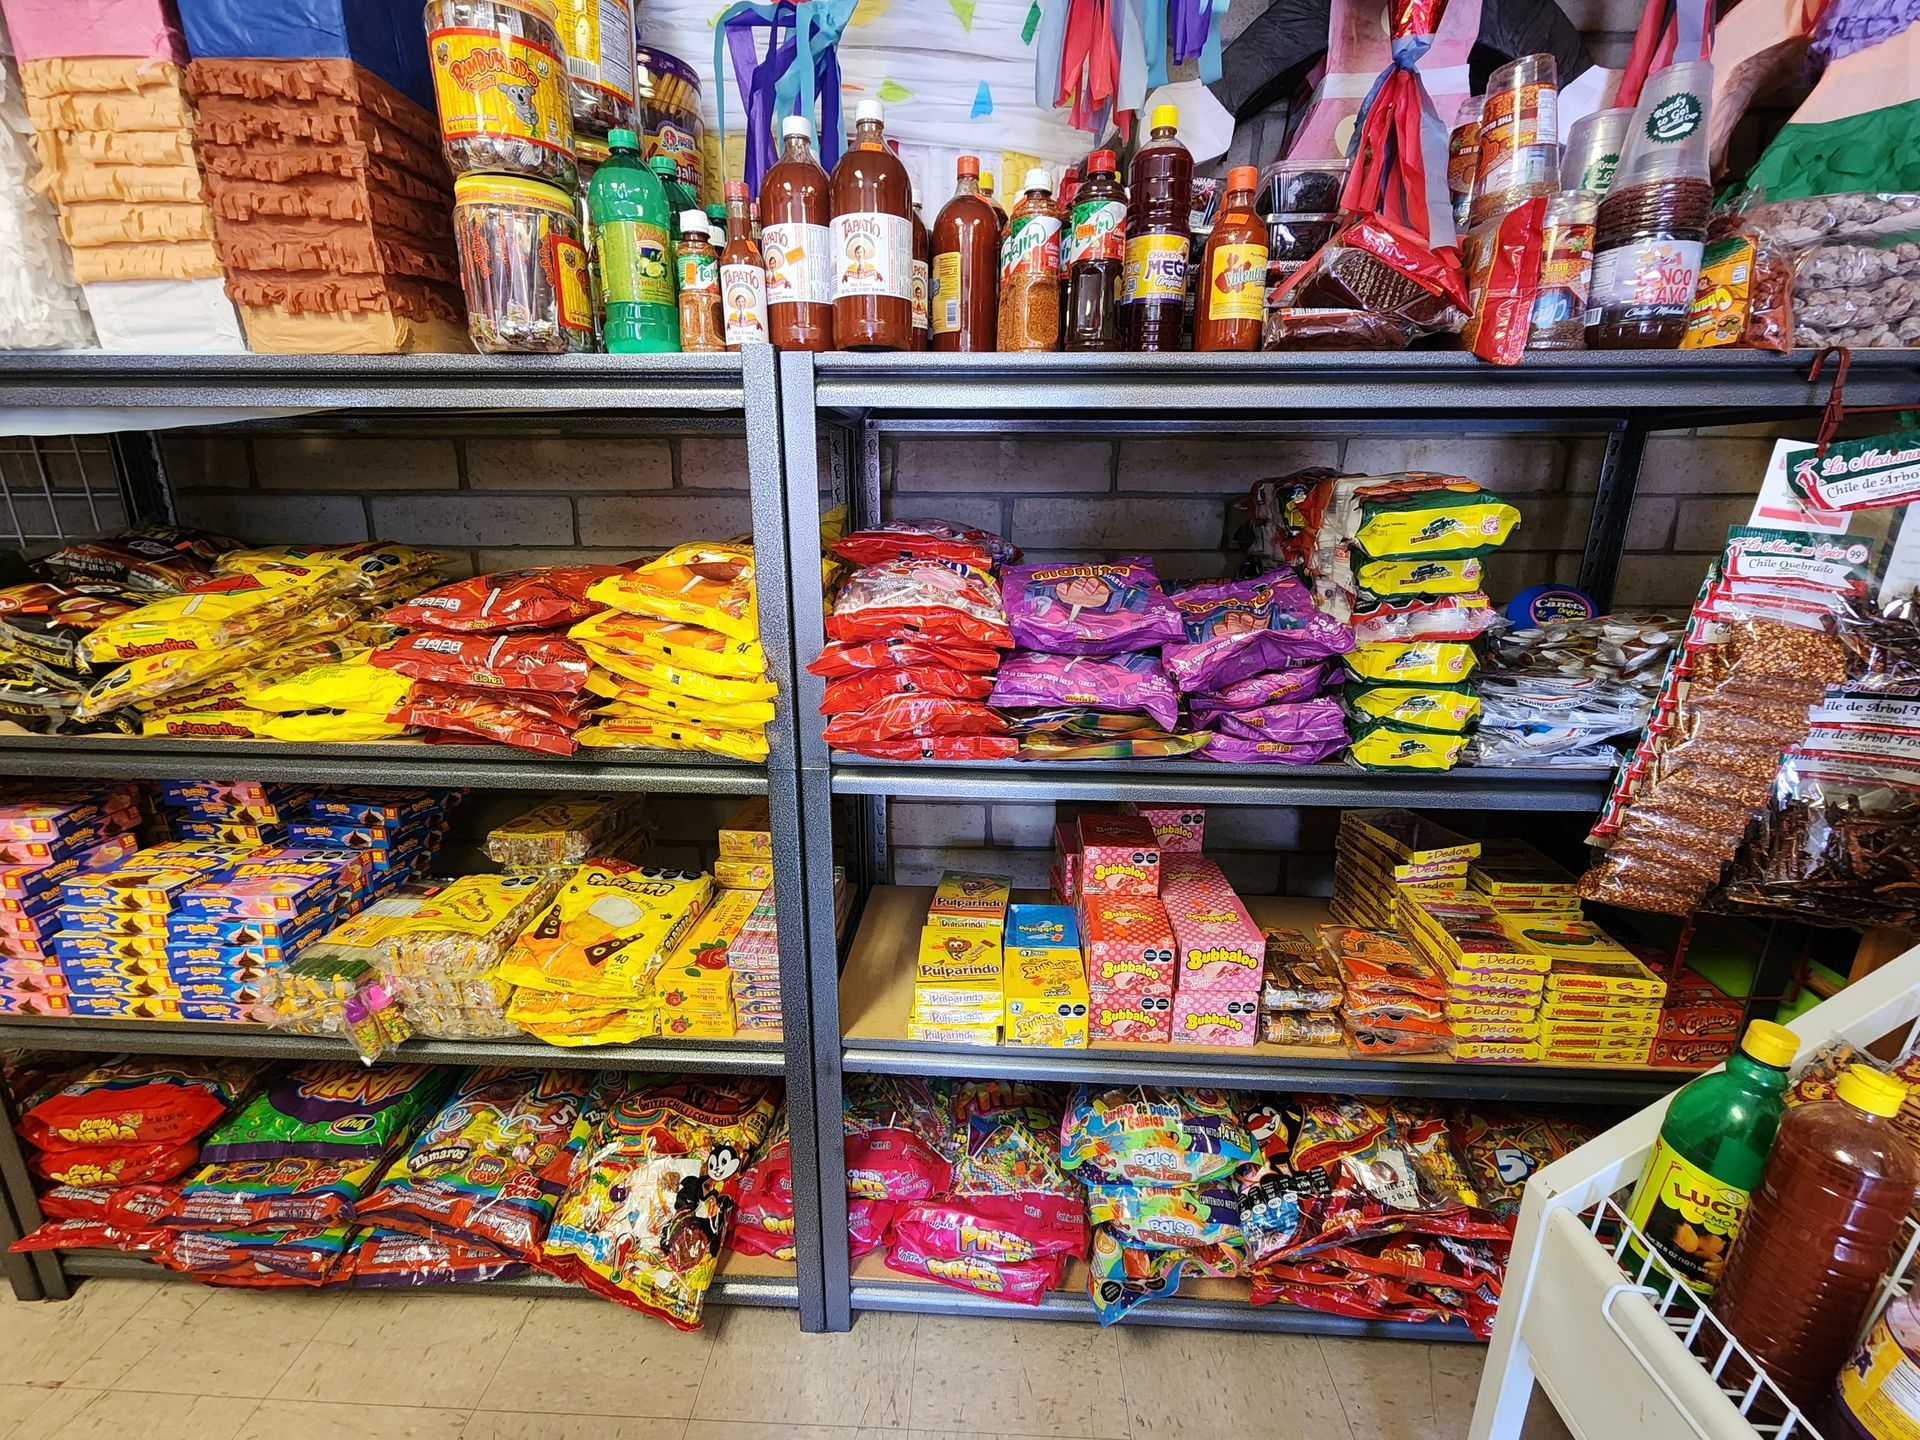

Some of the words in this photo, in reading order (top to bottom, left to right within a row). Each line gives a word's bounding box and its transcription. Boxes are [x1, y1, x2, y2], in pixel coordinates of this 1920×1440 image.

[450, 49, 539, 90] BAMBURINDO
[1653, 97, 1687, 118] Ready
[1657, 117, 1669, 127] to
[1671, 104, 1690, 120] Go!
[842, 217, 881, 241] TAPATÍO
[723, 269, 759, 289] TAPATÍO
[1822, 455, 1847, 475] La
[1827, 483, 1860, 499] Chile
[1862, 480, 1877, 490] de
[1032, 565, 1130, 580] manita
[1749, 559, 1777, 569] Chile
[1779, 561, 1834, 575] Quebrado
[1846, 701, 1863, 711] de
[1831, 730, 1847, 740] de
[1434, 848, 1470, 859] Dedos
[231, 862, 333, 878] Duvalin
[1093, 863, 1147, 881] Bubbaloo
[1416, 864, 1455, 875] Dedos
[587, 872, 675, 897] TARRITO
[937, 897, 1004, 908] Pulparindo
[718, 913, 743, 937] Rosa
[614, 953, 630, 963] 40
[1186, 948, 1258, 970] Bubbaloo
[1487, 955, 1536, 967] Dedos
[920, 964, 1000, 976] Pulparindo
[1101, 960, 1160, 981] Bubbaloo
[1479, 974, 1528, 985] Dedos
[1099, 1008, 1157, 1028] Bubbaloo
[1480, 1006, 1523, 1017] Dedos
[1185, 1012, 1243, 1031] Bubbaloo
[1479, 1024, 1524, 1035] Dedos
[1480, 1044, 1524, 1055] Dedos
[641, 1099, 666, 1110] WITH
[667, 1099, 689, 1114] CHILI
[693, 1111, 711, 1124] CON
[712, 1116, 738, 1126] CHILE
[1136, 1102, 1148, 1116] de
[1148, 1102, 1181, 1117] Dulces
[1120, 1119, 1126, 1132] y
[1134, 1151, 1178, 1169] BOLSA
[1495, 1149, 1525, 1183] 5
[1199, 1195, 1224, 1208] CONTENIDO
[1694, 1207, 1740, 1229] LEMON
[1149, 1219, 1194, 1236] BOLSA
